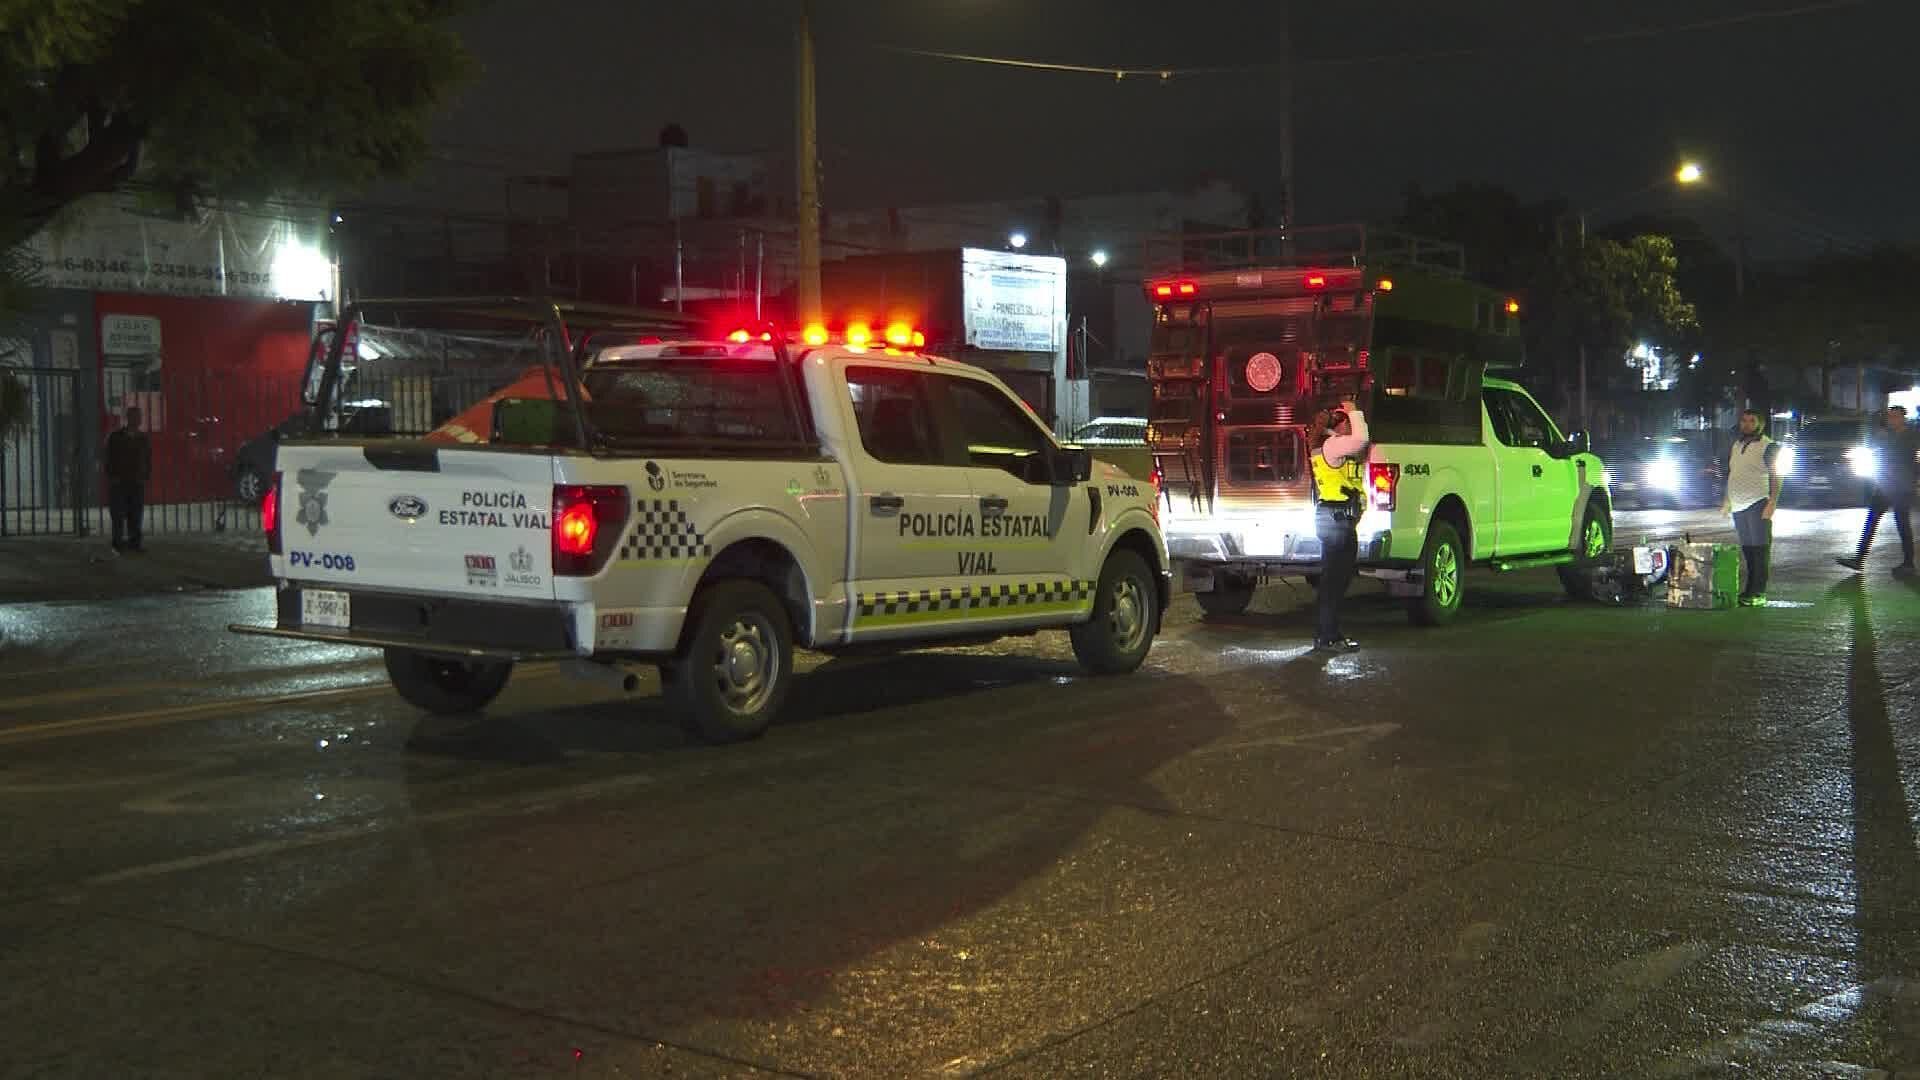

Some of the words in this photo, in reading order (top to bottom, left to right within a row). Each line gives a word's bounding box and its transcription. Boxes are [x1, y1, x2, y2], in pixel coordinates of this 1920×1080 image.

[462, 490, 527, 510] POLICÍA
[439, 510, 507, 528] ESTATAL
[513, 514, 552, 530] VIAL
[899, 508, 974, 537] POLICÍA
[980, 514, 1051, 538] ESTATAL
[289, 551, 356, 572] PV-008
[957, 551, 998, 575] VIAL
